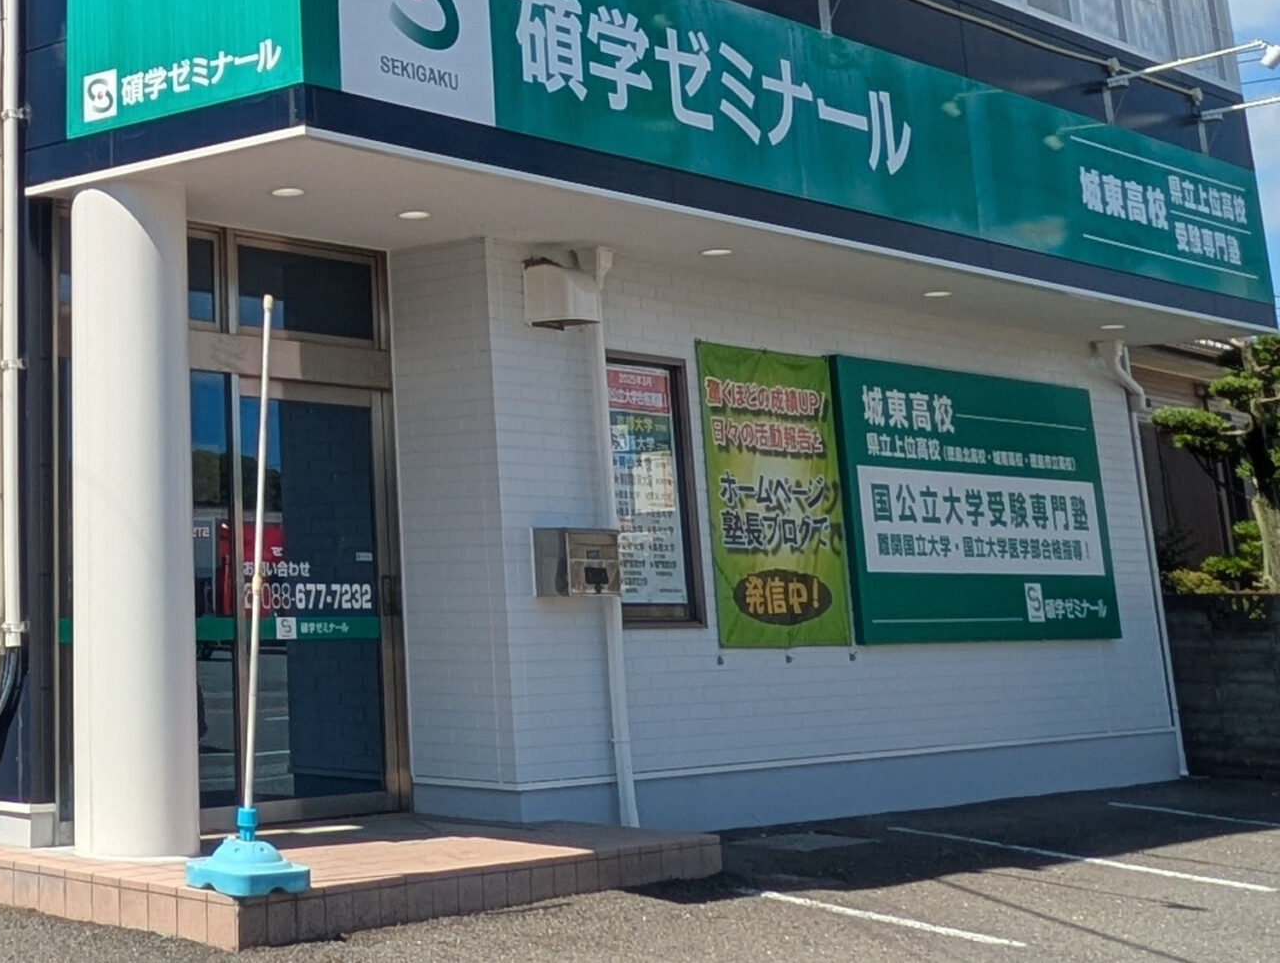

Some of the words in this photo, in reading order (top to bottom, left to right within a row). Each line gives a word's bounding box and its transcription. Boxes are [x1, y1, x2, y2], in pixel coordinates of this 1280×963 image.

[120, 38, 282, 107] 碩学ゼミナール
[380, 55, 459, 91] SEKIGAKU
[861, 384, 956, 434] 城東高校
[865, 431, 942, 461] 県立上位高校
[719, 472, 825, 509] ホームページ
[870, 482, 1090, 532] 国公立大学受験専門塾
[720, 509, 829, 549] 塾長ブログで
